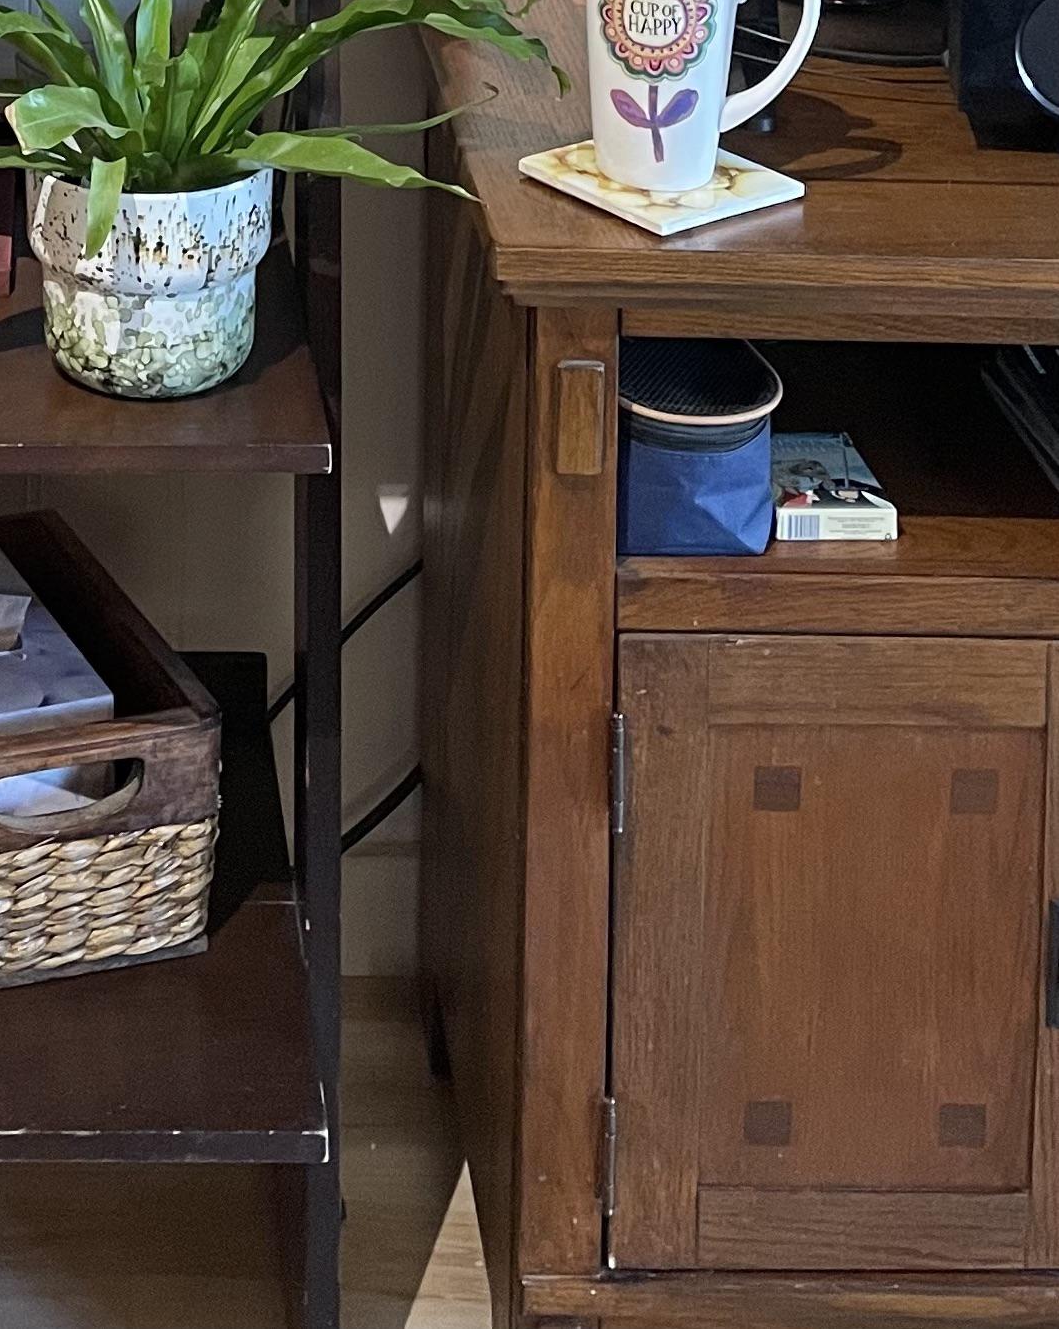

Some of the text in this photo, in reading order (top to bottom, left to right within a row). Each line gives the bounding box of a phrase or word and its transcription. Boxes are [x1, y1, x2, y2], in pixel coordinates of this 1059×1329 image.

[630, 0, 679, 17] CUP OF
[627, 17, 683, 37] HAPPY
